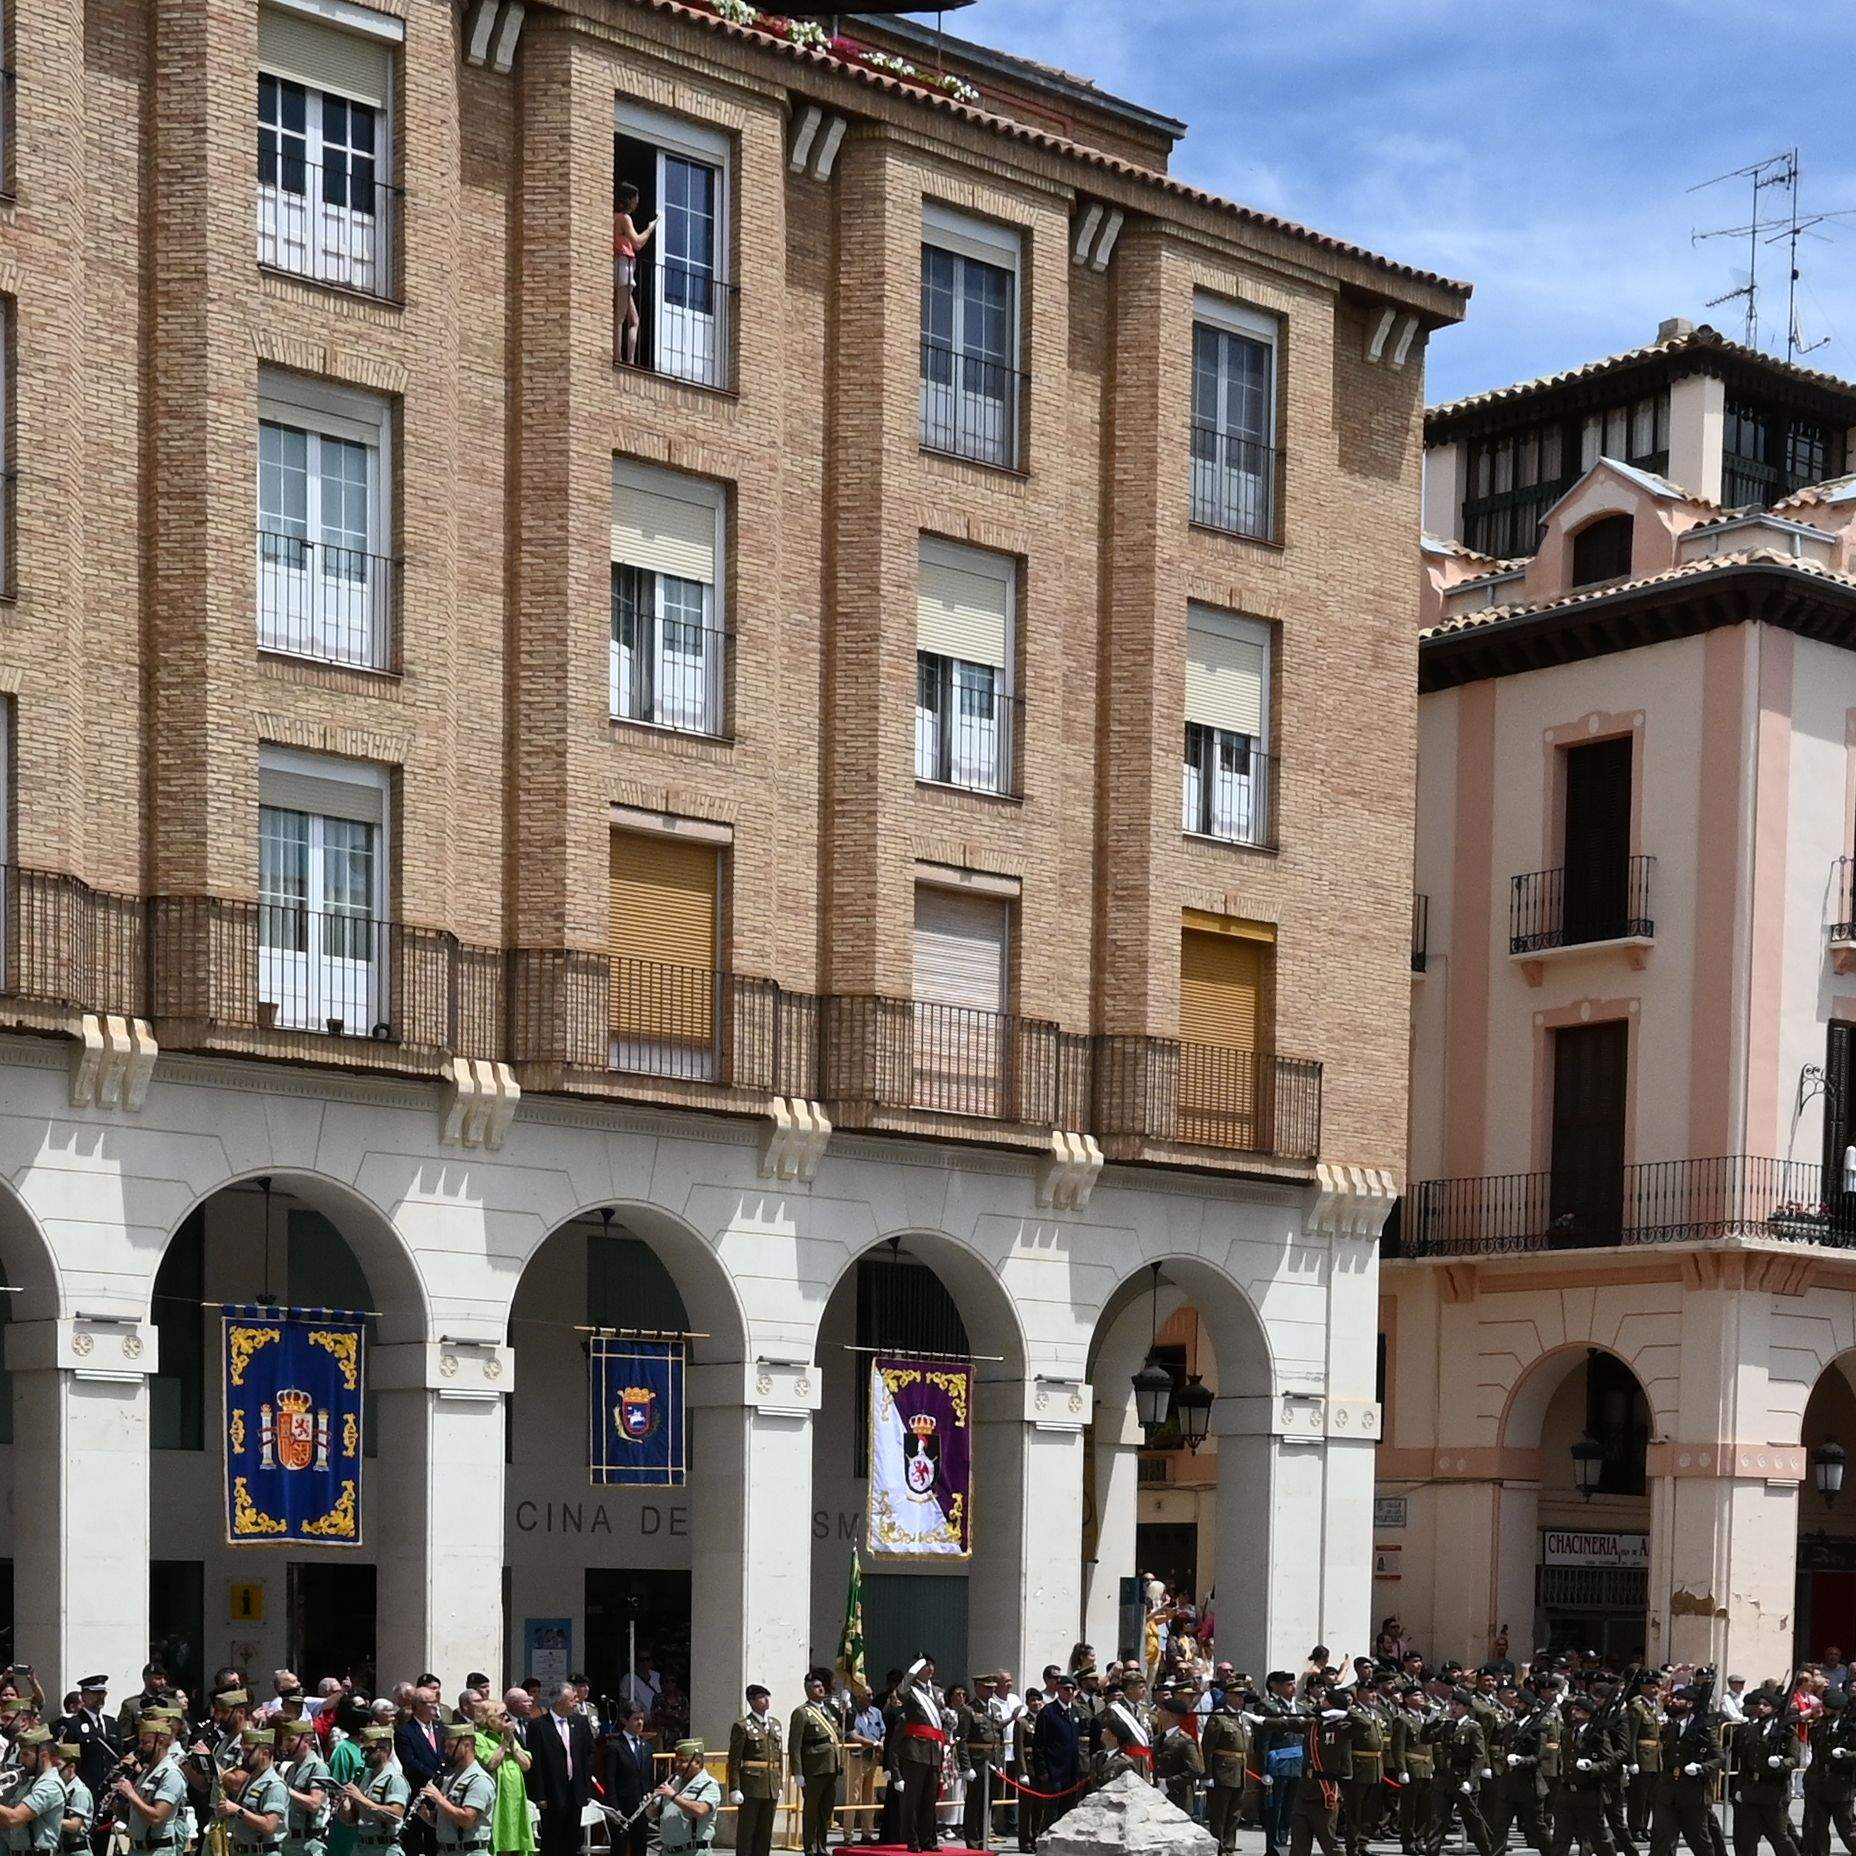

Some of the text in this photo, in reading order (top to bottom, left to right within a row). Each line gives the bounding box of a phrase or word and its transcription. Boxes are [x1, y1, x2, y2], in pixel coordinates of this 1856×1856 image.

[515, 1501, 613, 1535] CINA
[640, 1505, 688, 1537] DE
[1548, 1534, 1618, 1556] CHACINERIA
